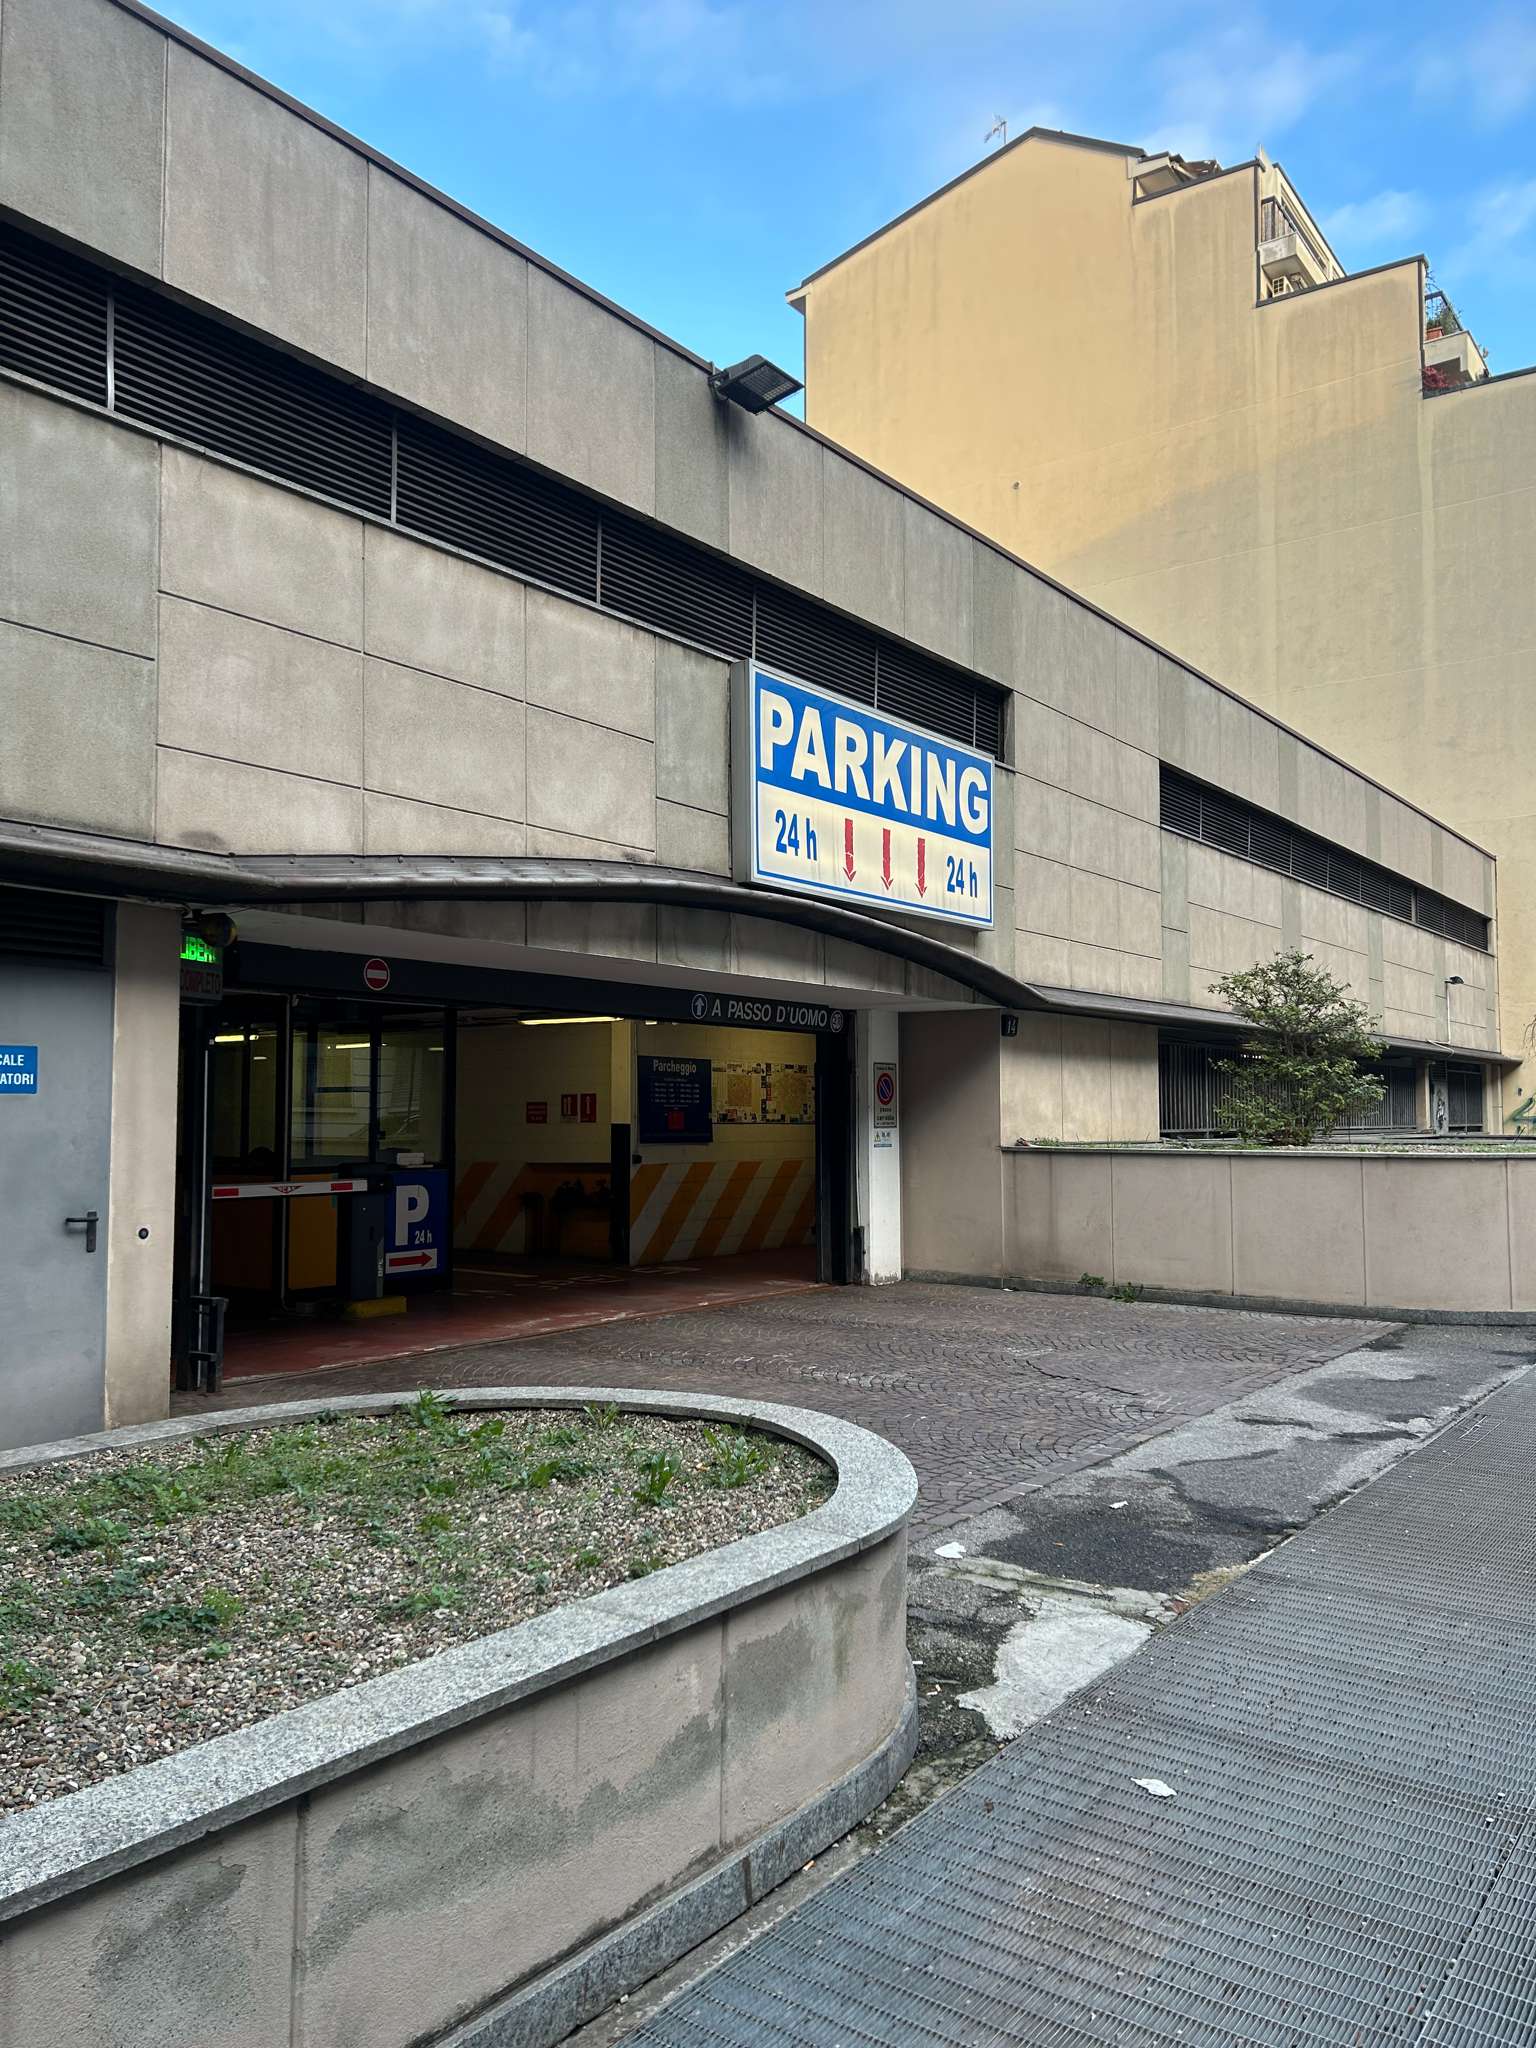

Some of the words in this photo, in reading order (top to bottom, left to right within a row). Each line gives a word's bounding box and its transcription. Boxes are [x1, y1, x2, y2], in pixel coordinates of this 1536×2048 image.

[760, 688, 988, 835] PARKING
[775, 809, 799, 857] 24
[805, 817, 817, 861] h
[946, 855, 965, 895] 24
[969, 861, 978, 898] h
[711, 999, 721, 1017] A
[727, 1000, 772, 1022] PASSO
[776, 1005, 828, 1027] D'UOMO
[652, 1058, 697, 1076] Parcheggio
[395, 1184, 430, 1247] P
[414, 1229, 425, 1245] 24
[426, 1229, 433, 1245] h
